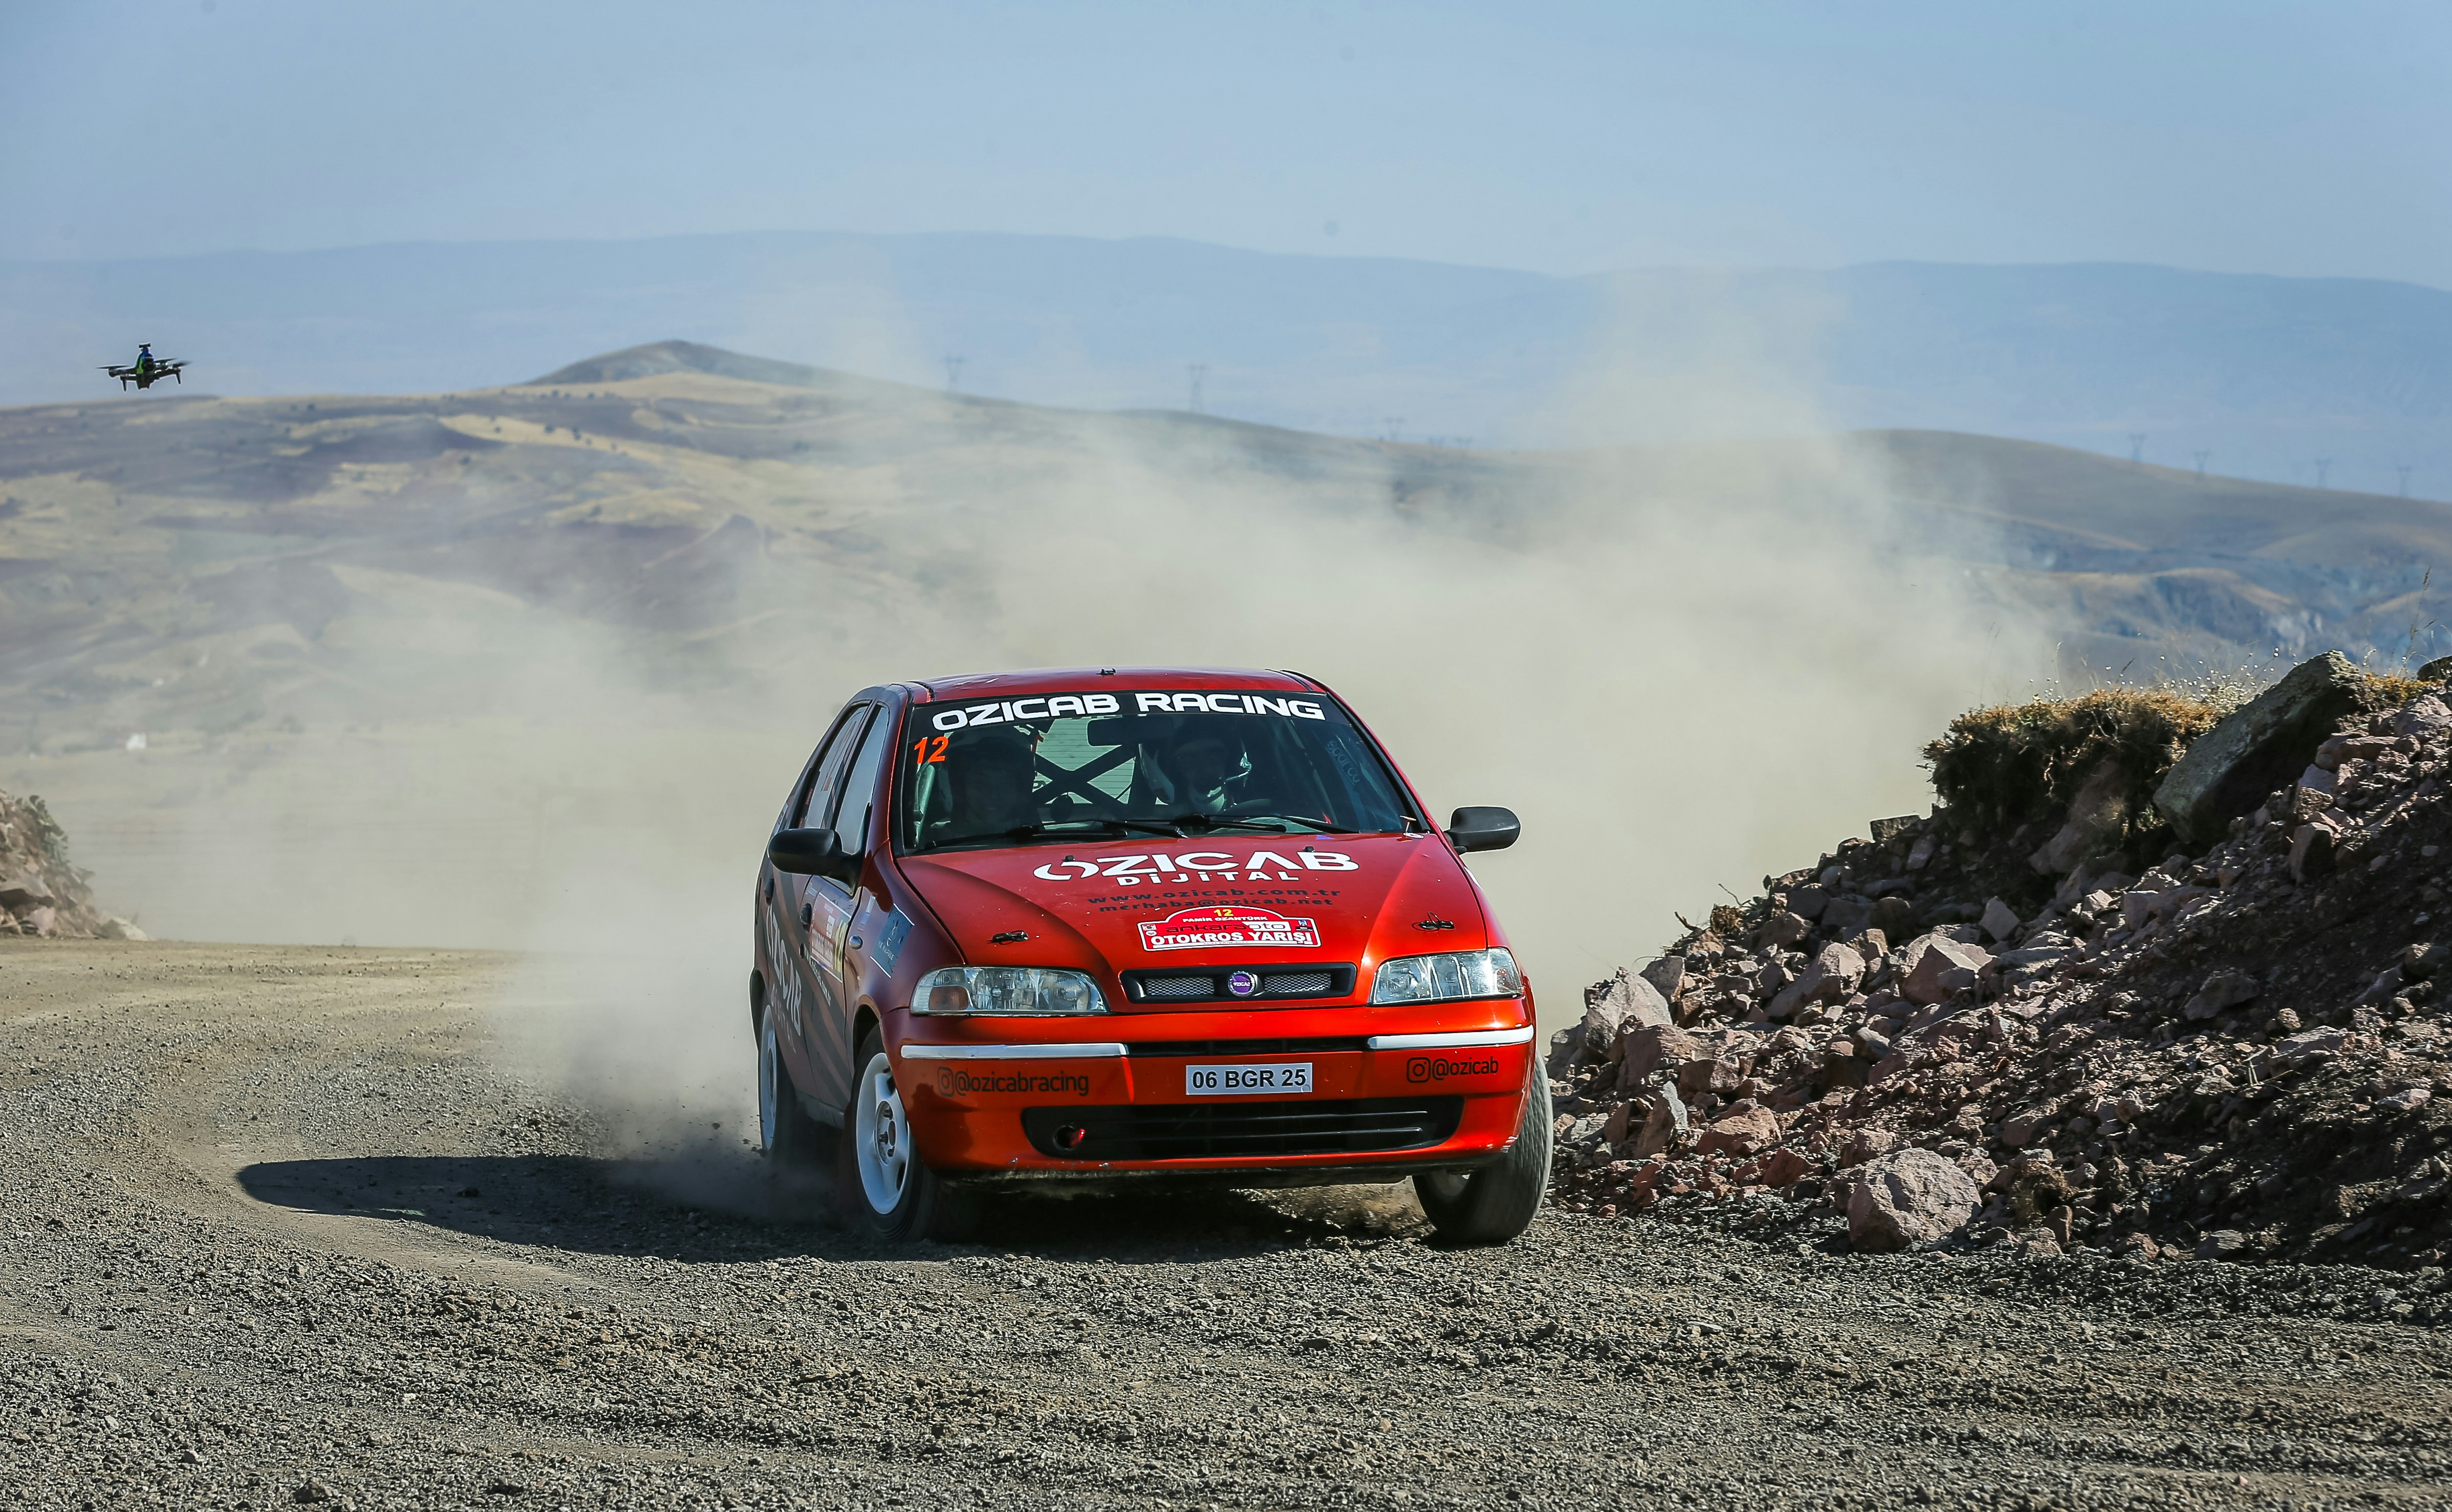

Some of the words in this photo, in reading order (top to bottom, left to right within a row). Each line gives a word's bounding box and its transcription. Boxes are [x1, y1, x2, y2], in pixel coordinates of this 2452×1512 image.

[931, 693, 1120, 731] OZICAB
[1134, 693, 1326, 721] RACING
[914, 736, 949, 764] 12
[1033, 850, 1360, 881] OZICAB
[1087, 888, 1341, 905] www.ozicab.com.tr
[1099, 898, 1334, 912] merhaba@ozicab.net
[1151, 932, 1245, 946] OTOKROS
[1248, 931, 1313, 944] YARIŞI
[1192, 1071, 1218, 1089] 06
[1225, 1069, 1276, 1088] BGR
[1281, 1068, 1306, 1087] 25
[1433, 1055, 1500, 1081] @ozicab
[954, 1070, 1090, 1097] @ozicabracing
